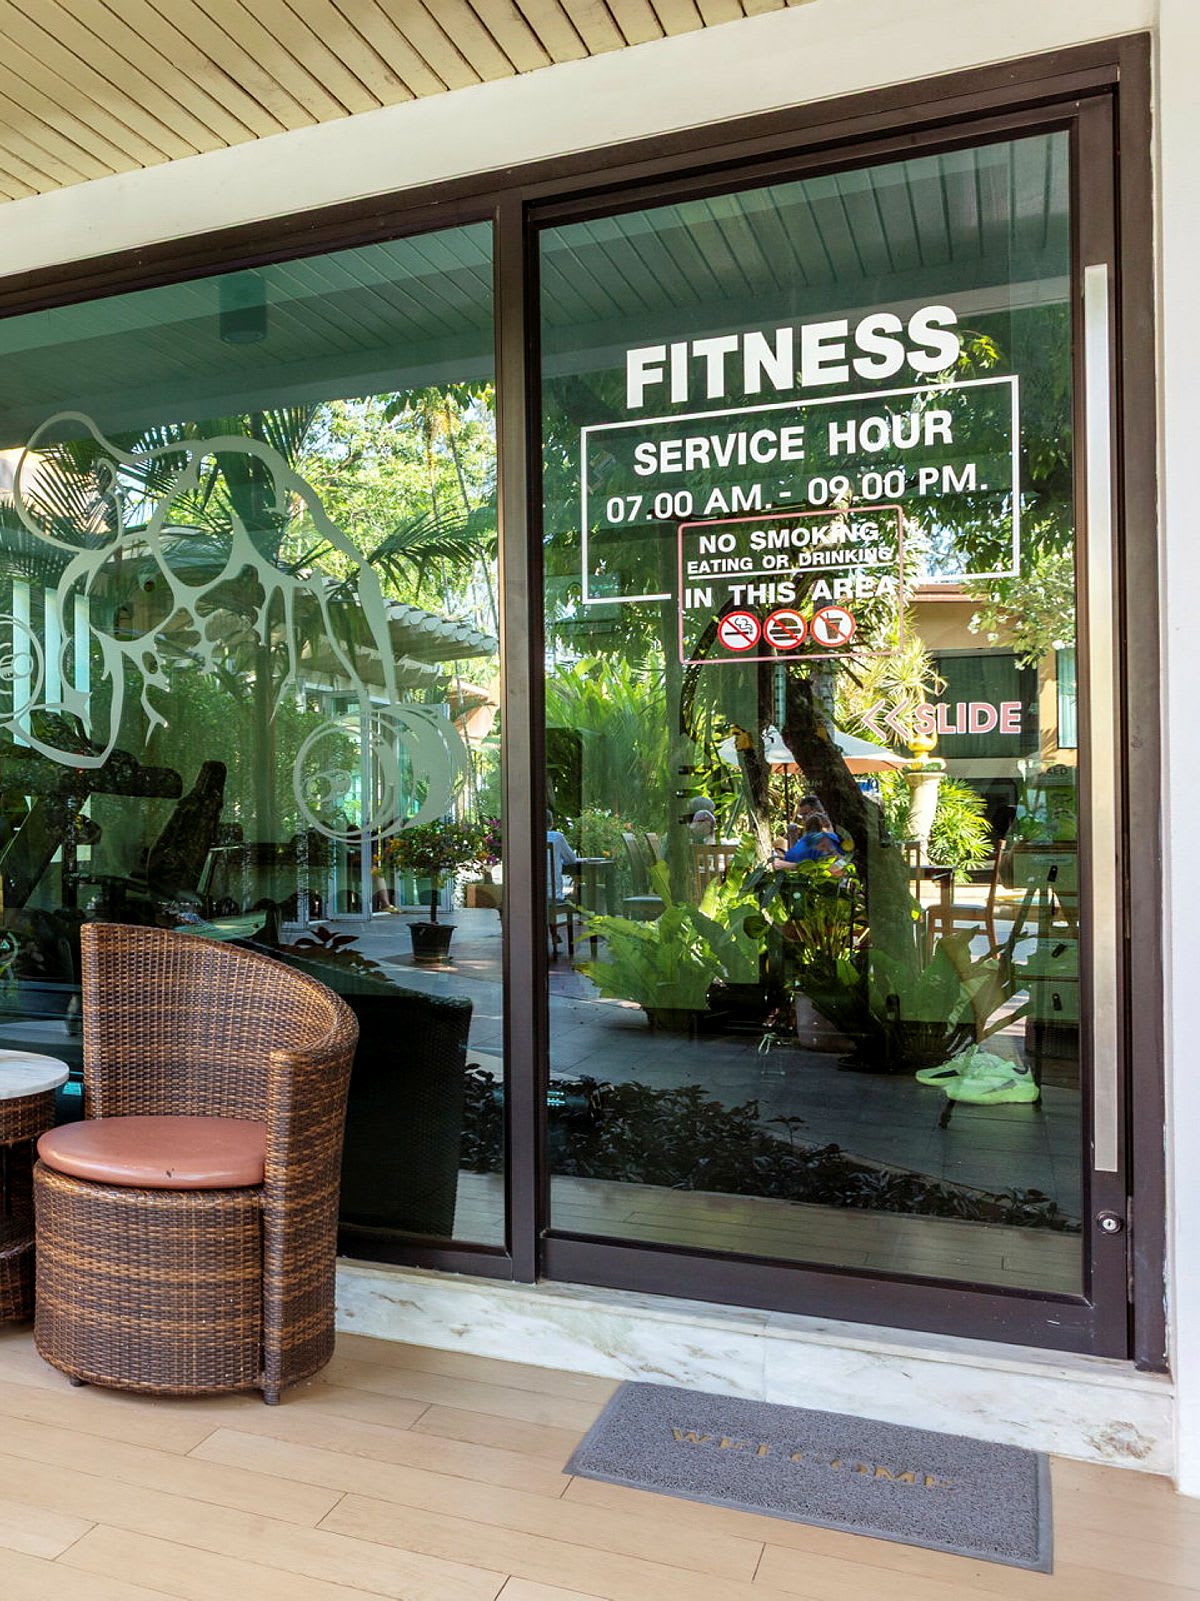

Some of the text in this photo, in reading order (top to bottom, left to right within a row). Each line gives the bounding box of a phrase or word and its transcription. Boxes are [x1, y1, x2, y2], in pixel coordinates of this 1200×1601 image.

[626, 305, 961, 409] FITNESS
[633, 410, 953, 476] SERVICE HOUR
[606, 491, 693, 524] 07.00
[704, 484, 772, 514] AM.
[808, 470, 904, 505] 09.00
[919, 464, 988, 495] PM.
[700, 521, 879, 553] NO SMOKING
[687, 548, 892, 574] EATING OR DRINKING
[685, 574, 896, 609] IN THIS AREA
[913, 701, 1022, 734] SLIDE
